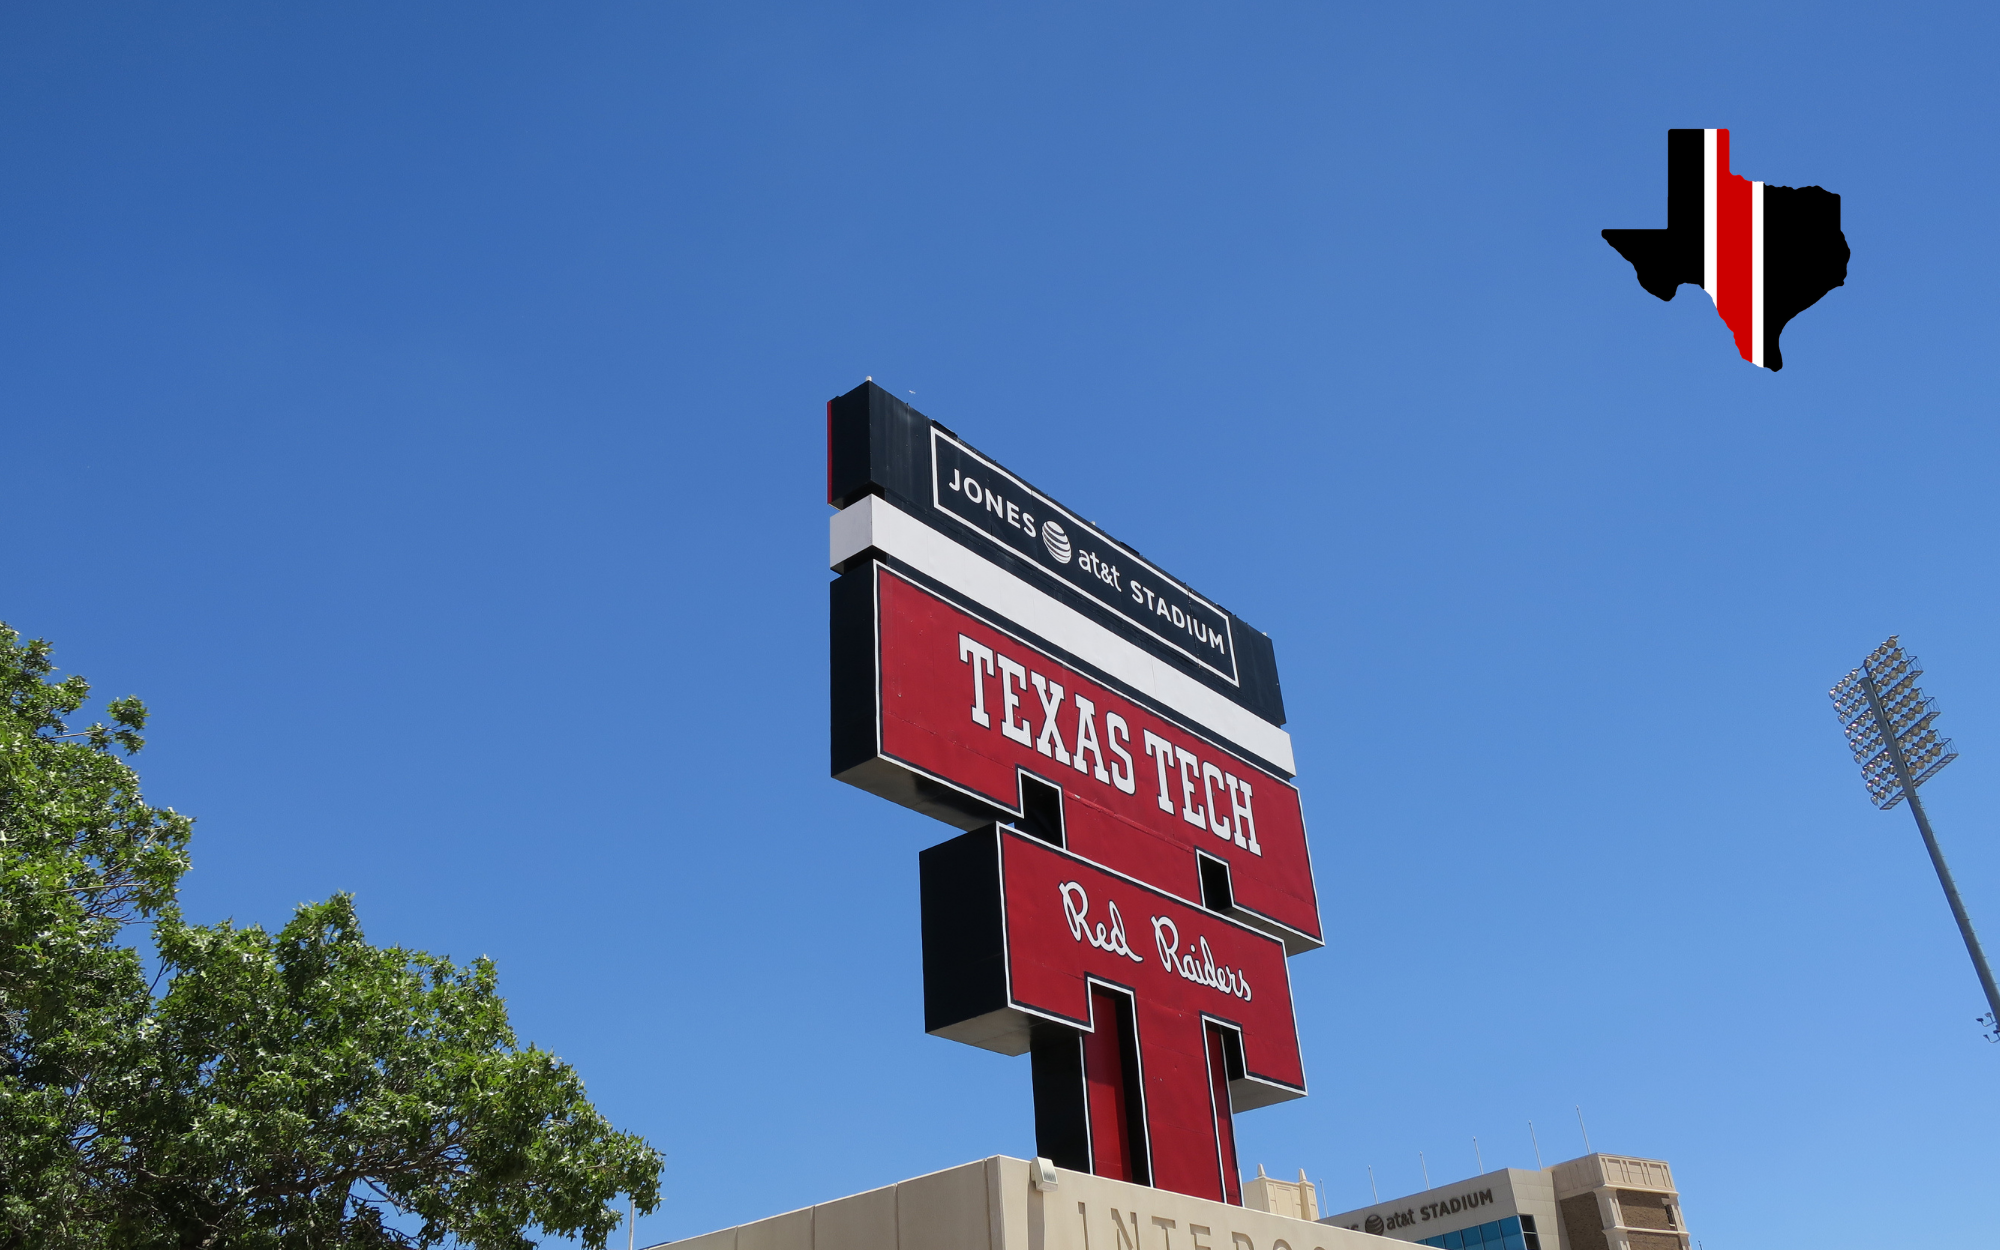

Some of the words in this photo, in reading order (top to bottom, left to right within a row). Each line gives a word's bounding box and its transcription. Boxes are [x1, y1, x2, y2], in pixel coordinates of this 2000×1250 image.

[948, 468, 1037, 538] JONES
[1078, 548, 1122, 592] at&t
[1130, 579, 1225, 655] STADIUM
[958, 632, 1137, 795] TEXAS
[1143, 728, 1262, 857] TECH
[1058, 877, 1144, 963] Red
[1150, 915, 1252, 1002] Raiders
[1386, 1208, 1416, 1231] at&t
[1420, 1188, 1494, 1222] STADIUM
